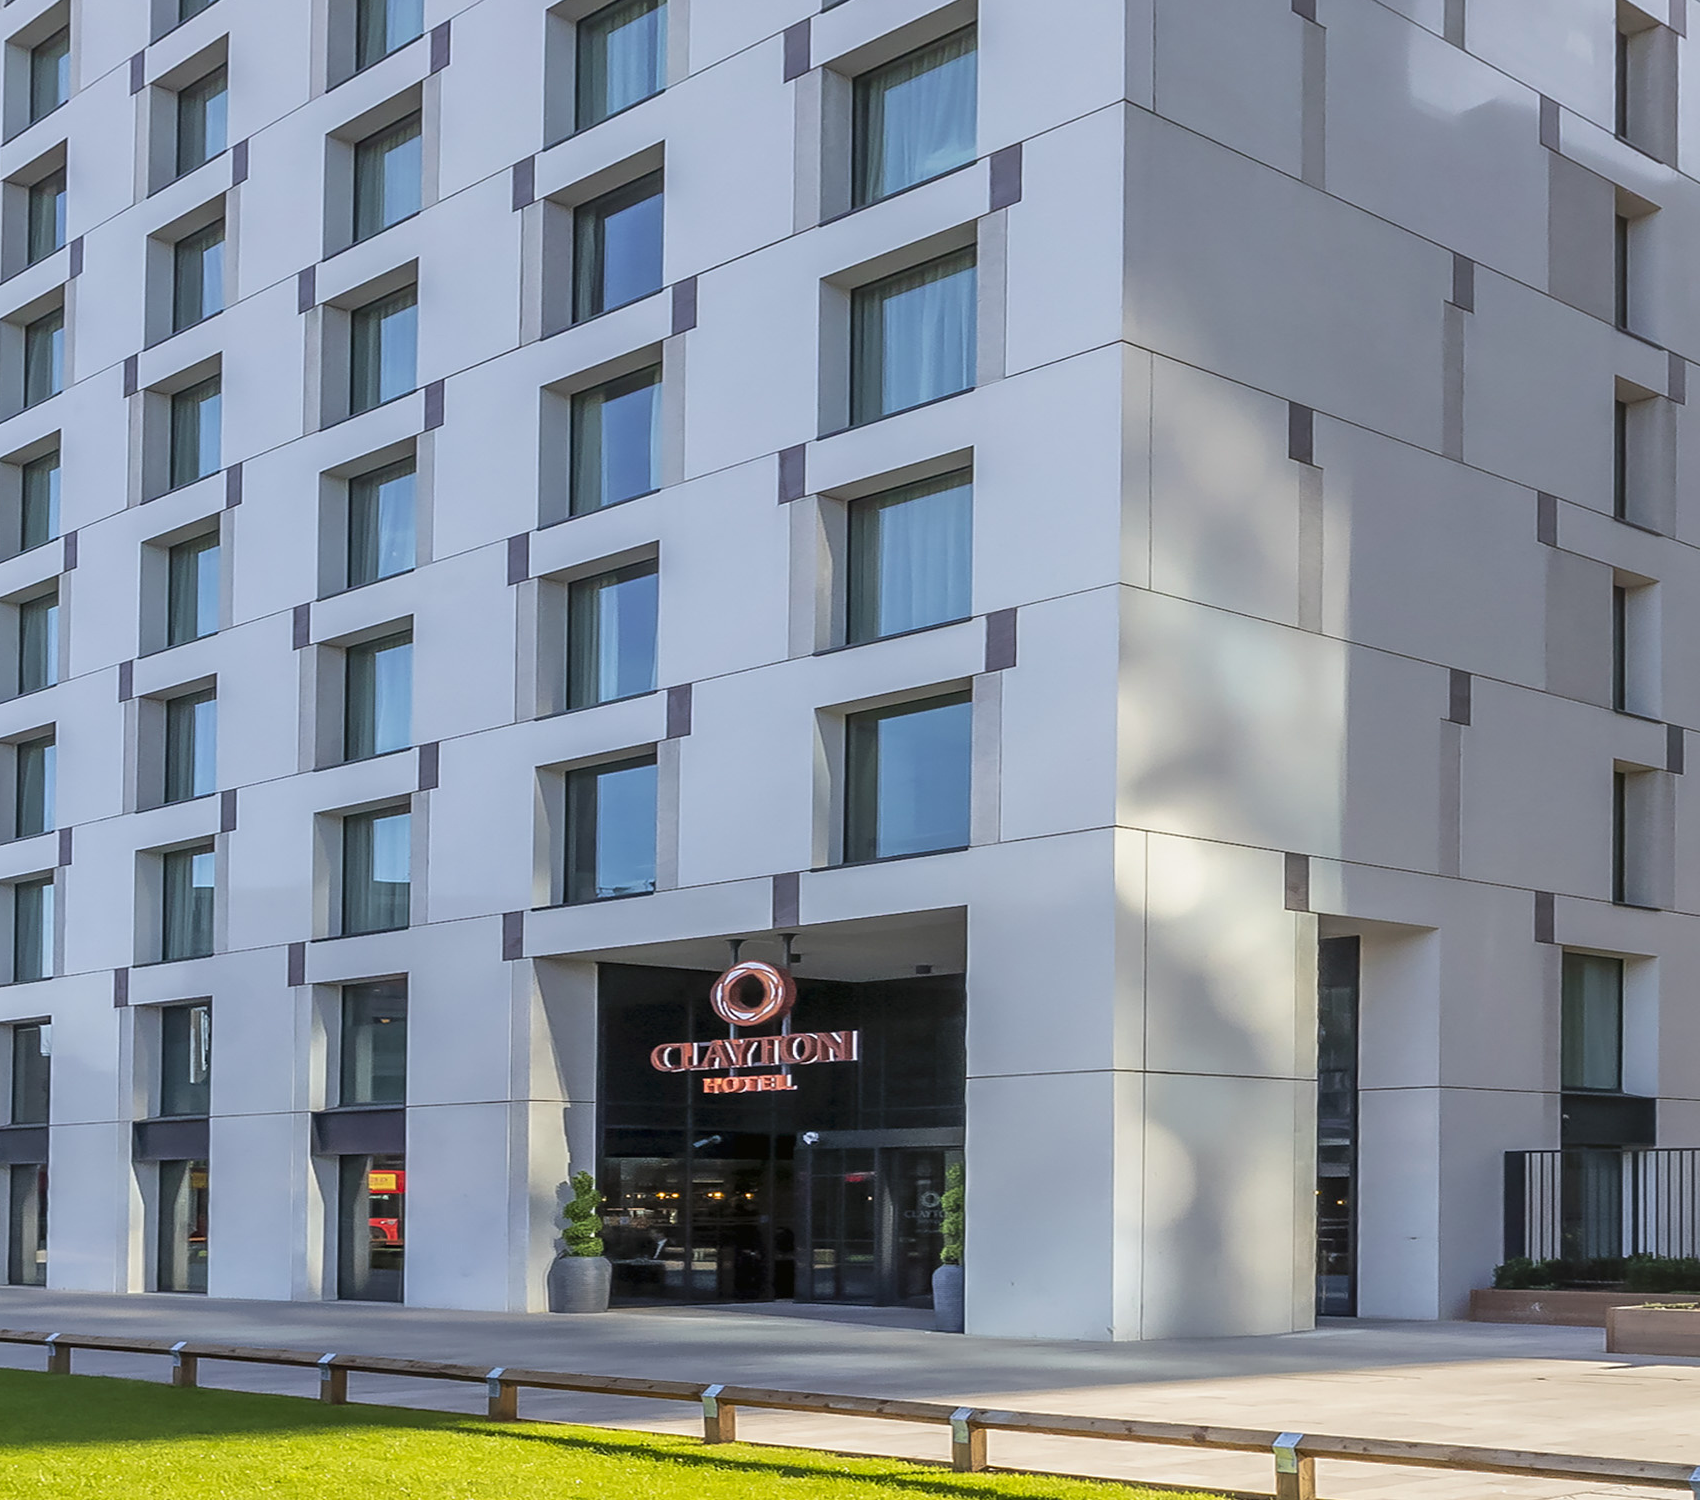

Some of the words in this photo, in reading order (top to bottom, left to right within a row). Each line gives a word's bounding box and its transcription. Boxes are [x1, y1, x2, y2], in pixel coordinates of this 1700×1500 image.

[650, 1030, 858, 1072] CLAYTON
[702, 1074, 798, 1094] HOTEL
[903, 1210, 948, 1218] CLAYTO
